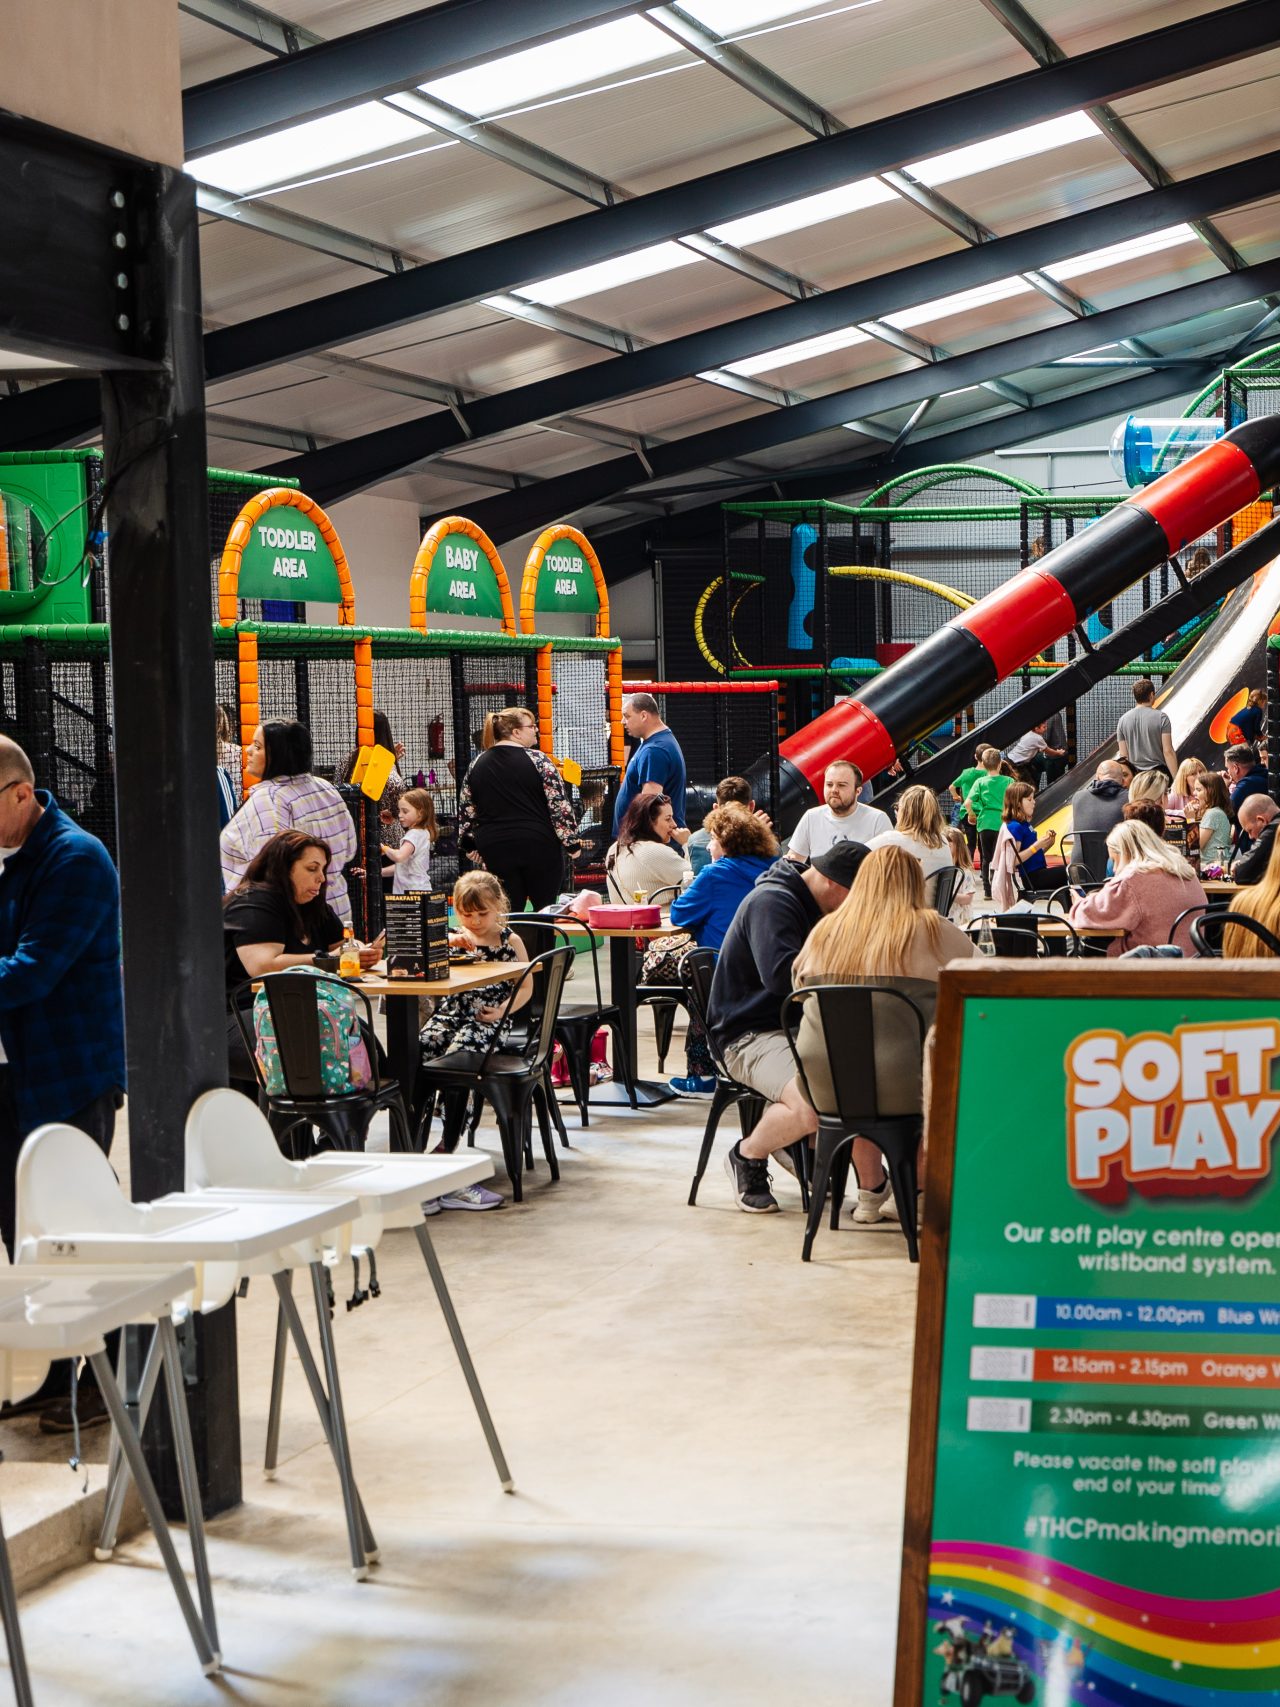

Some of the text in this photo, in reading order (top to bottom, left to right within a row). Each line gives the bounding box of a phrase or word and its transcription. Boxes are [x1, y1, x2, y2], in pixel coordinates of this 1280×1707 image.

[258, 526, 317, 552] TODDLER
[272, 556, 309, 579] AREA
[445, 545, 479, 572] BABY
[545, 554, 583, 574] TODDLER
[449, 580, 477, 600] AREA
[554, 578, 578, 596] AREA
[1071, 1026, 1277, 1108] SOFT
[1003, 1221, 1045, 1244] Our
[1049, 1223, 1092, 1244] soft
[1096, 1224, 1148, 1250] play
[1152, 1226, 1225, 1248] centre
[1077, 1250, 1278, 1279] wristband system.
[1055, 1303, 1123, 1322] 10.00am
[1137, 1305, 1205, 1327] 12.00pm
[1217, 1306, 1256, 1325] Blue
[1052, 1355, 1116, 1375] 12.15am
[1129, 1358, 1189, 1379] 2.15pm
[1201, 1359, 1268, 1382] Orange
[1049, 1407, 1112, 1429] 2.30pm
[1126, 1409, 1190, 1431] 4.30pm
[1203, 1411, 1259, 1430] Green
[1013, 1450, 1075, 1470] Please
[1078, 1454, 1143, 1472] vacate
[1147, 1456, 1178, 1473] the
[1181, 1456, 1217, 1475] soft
[1072, 1477, 1109, 1494] end
[1111, 1477, 1133, 1494] of
[1135, 1479, 1176, 1498] your
[1181, 1478, 1222, 1497] time
